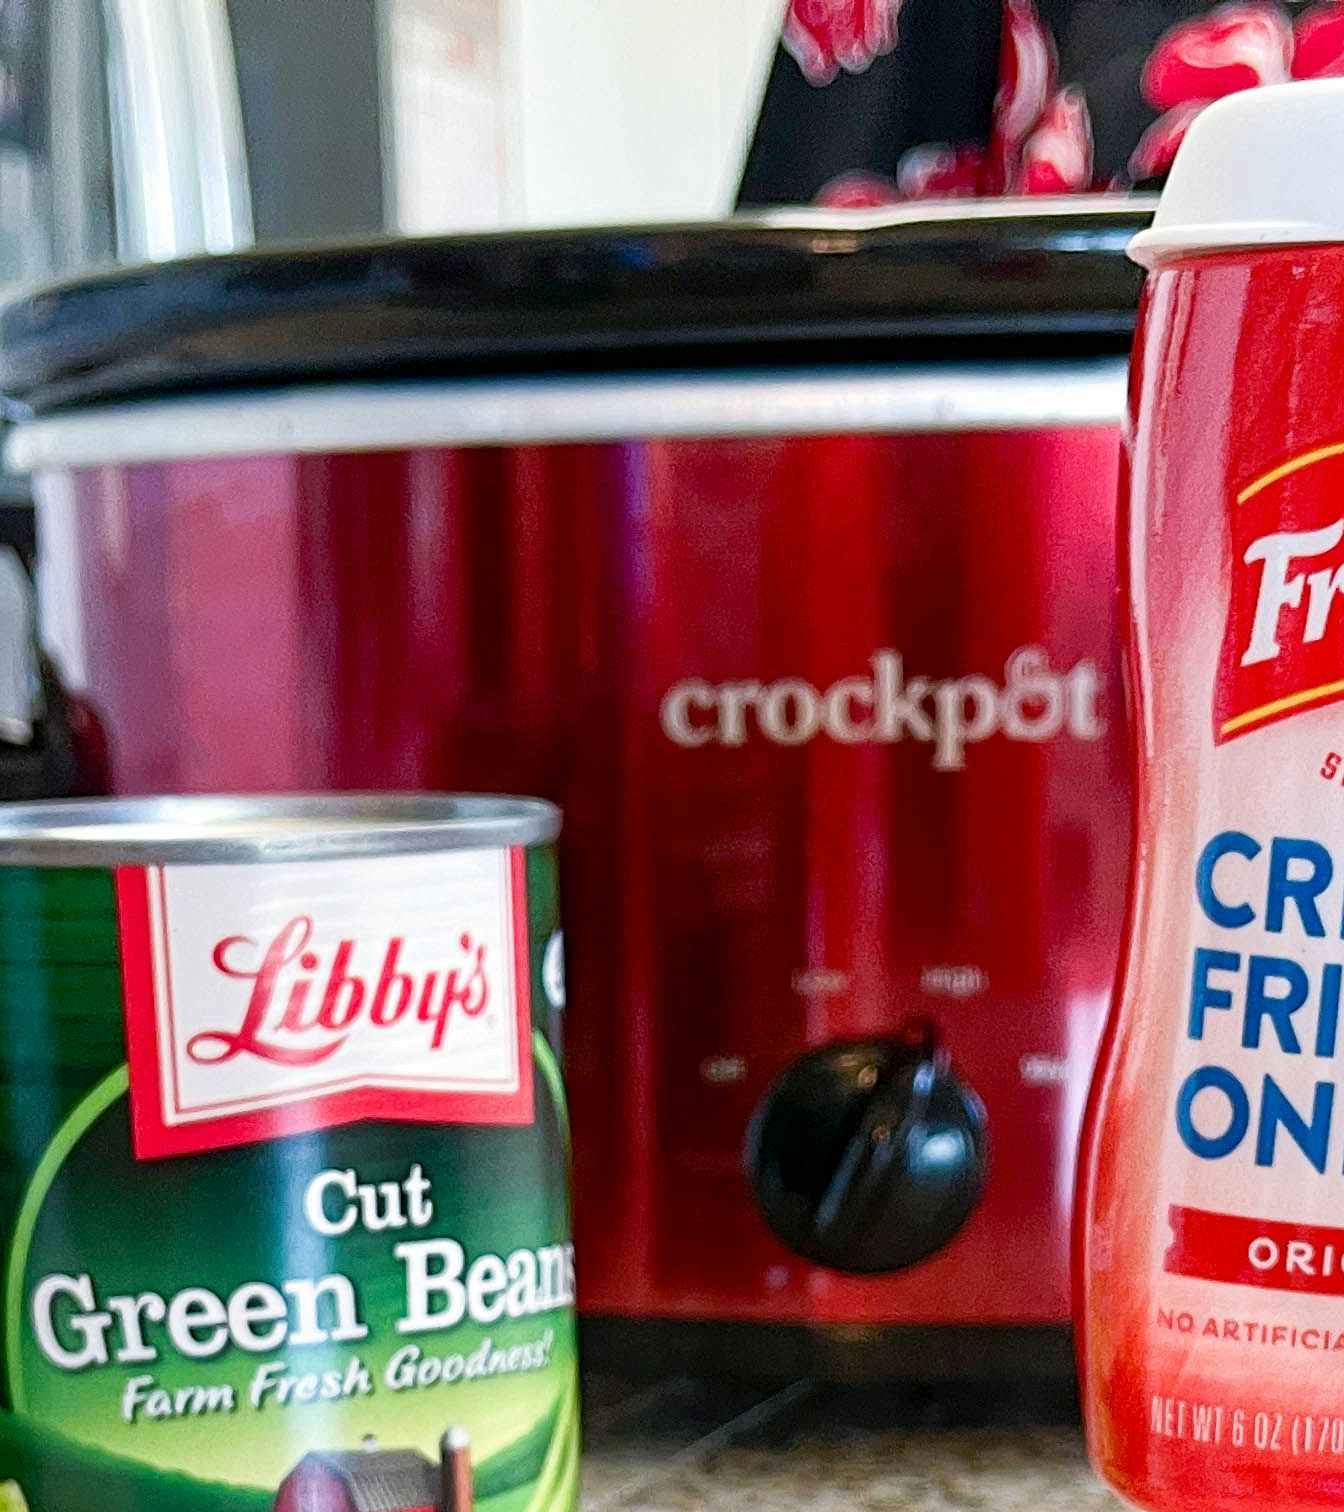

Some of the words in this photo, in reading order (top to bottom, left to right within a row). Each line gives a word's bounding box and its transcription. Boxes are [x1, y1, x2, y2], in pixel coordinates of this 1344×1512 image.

[661, 644, 1107, 771] crockpot
[187, 914, 490, 1067] Libby's
[304, 1163, 432, 1236] Cut
[31, 1272, 367, 1371] Green
[394, 1237, 576, 1334] Bean
[1157, 1309, 1193, 1333] NO
[122, 1375, 236, 1424] Farm
[250, 1357, 372, 1405] Fresh
[384, 1328, 554, 1391] Goodness!
[1151, 1396, 1184, 1436] NET
[1192, 1402, 1223, 1444] WT
[1232, 1407, 1245, 1447] 6
[1254, 1410, 1282, 1451] OZ
[1291, 1413, 1344, 1456] (170
